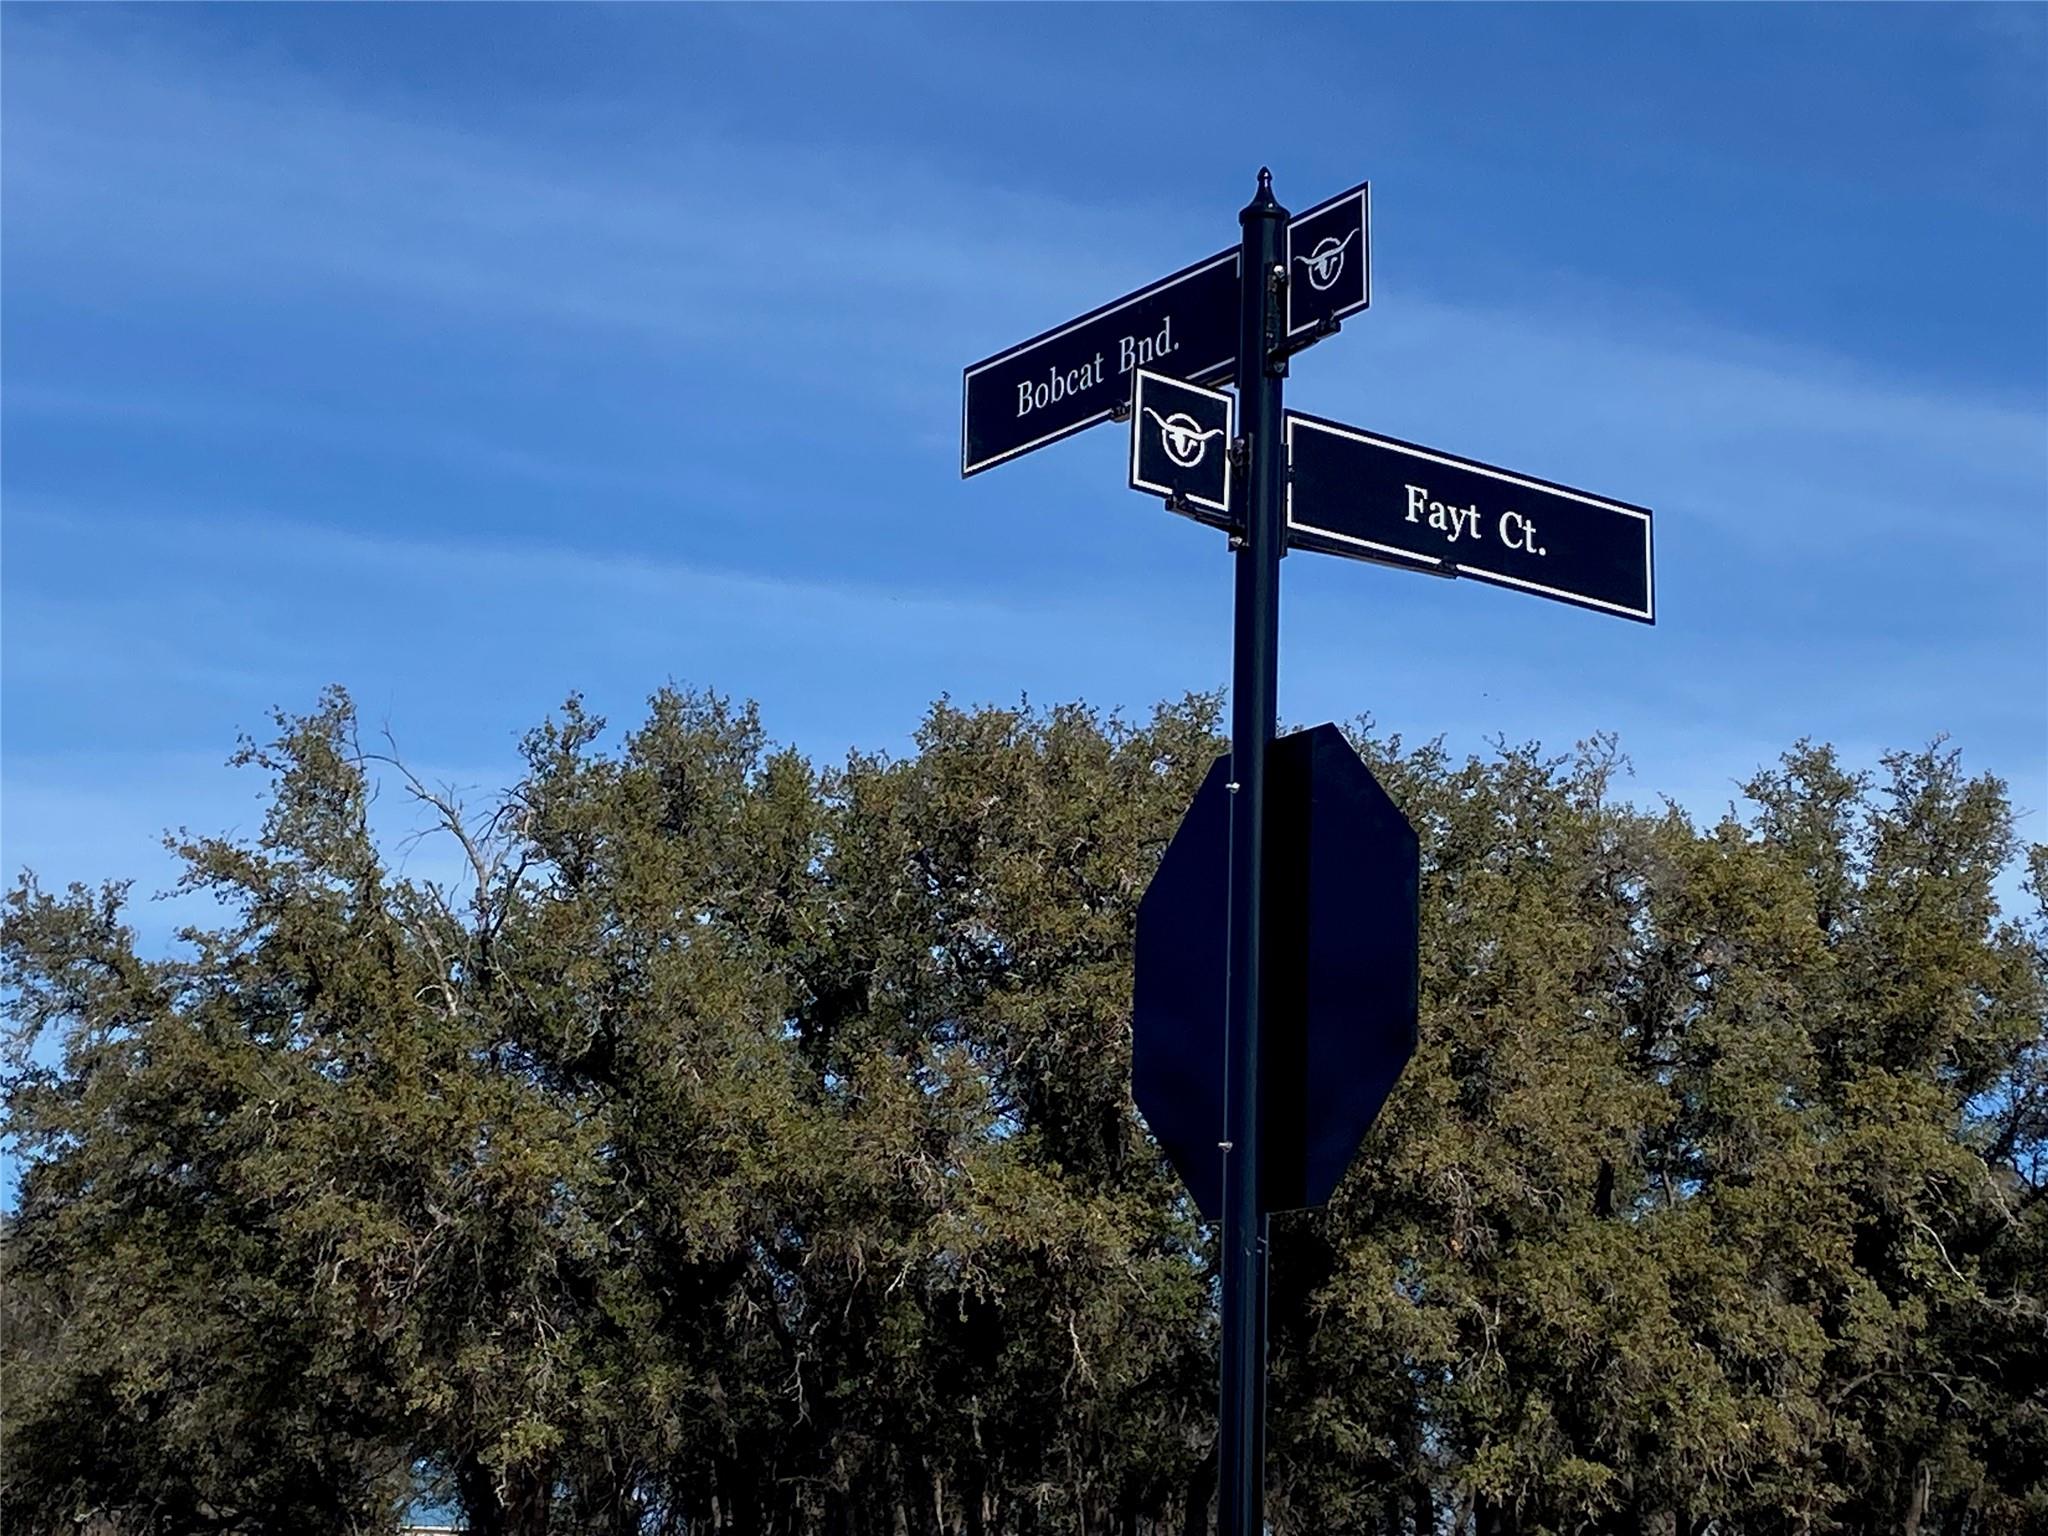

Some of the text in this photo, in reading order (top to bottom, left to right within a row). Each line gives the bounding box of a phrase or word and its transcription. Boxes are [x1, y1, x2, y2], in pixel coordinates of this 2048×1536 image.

[1017, 316, 1180, 418] Bobcat Bnd.
[1404, 484, 1547, 556] Fayt Ct.
